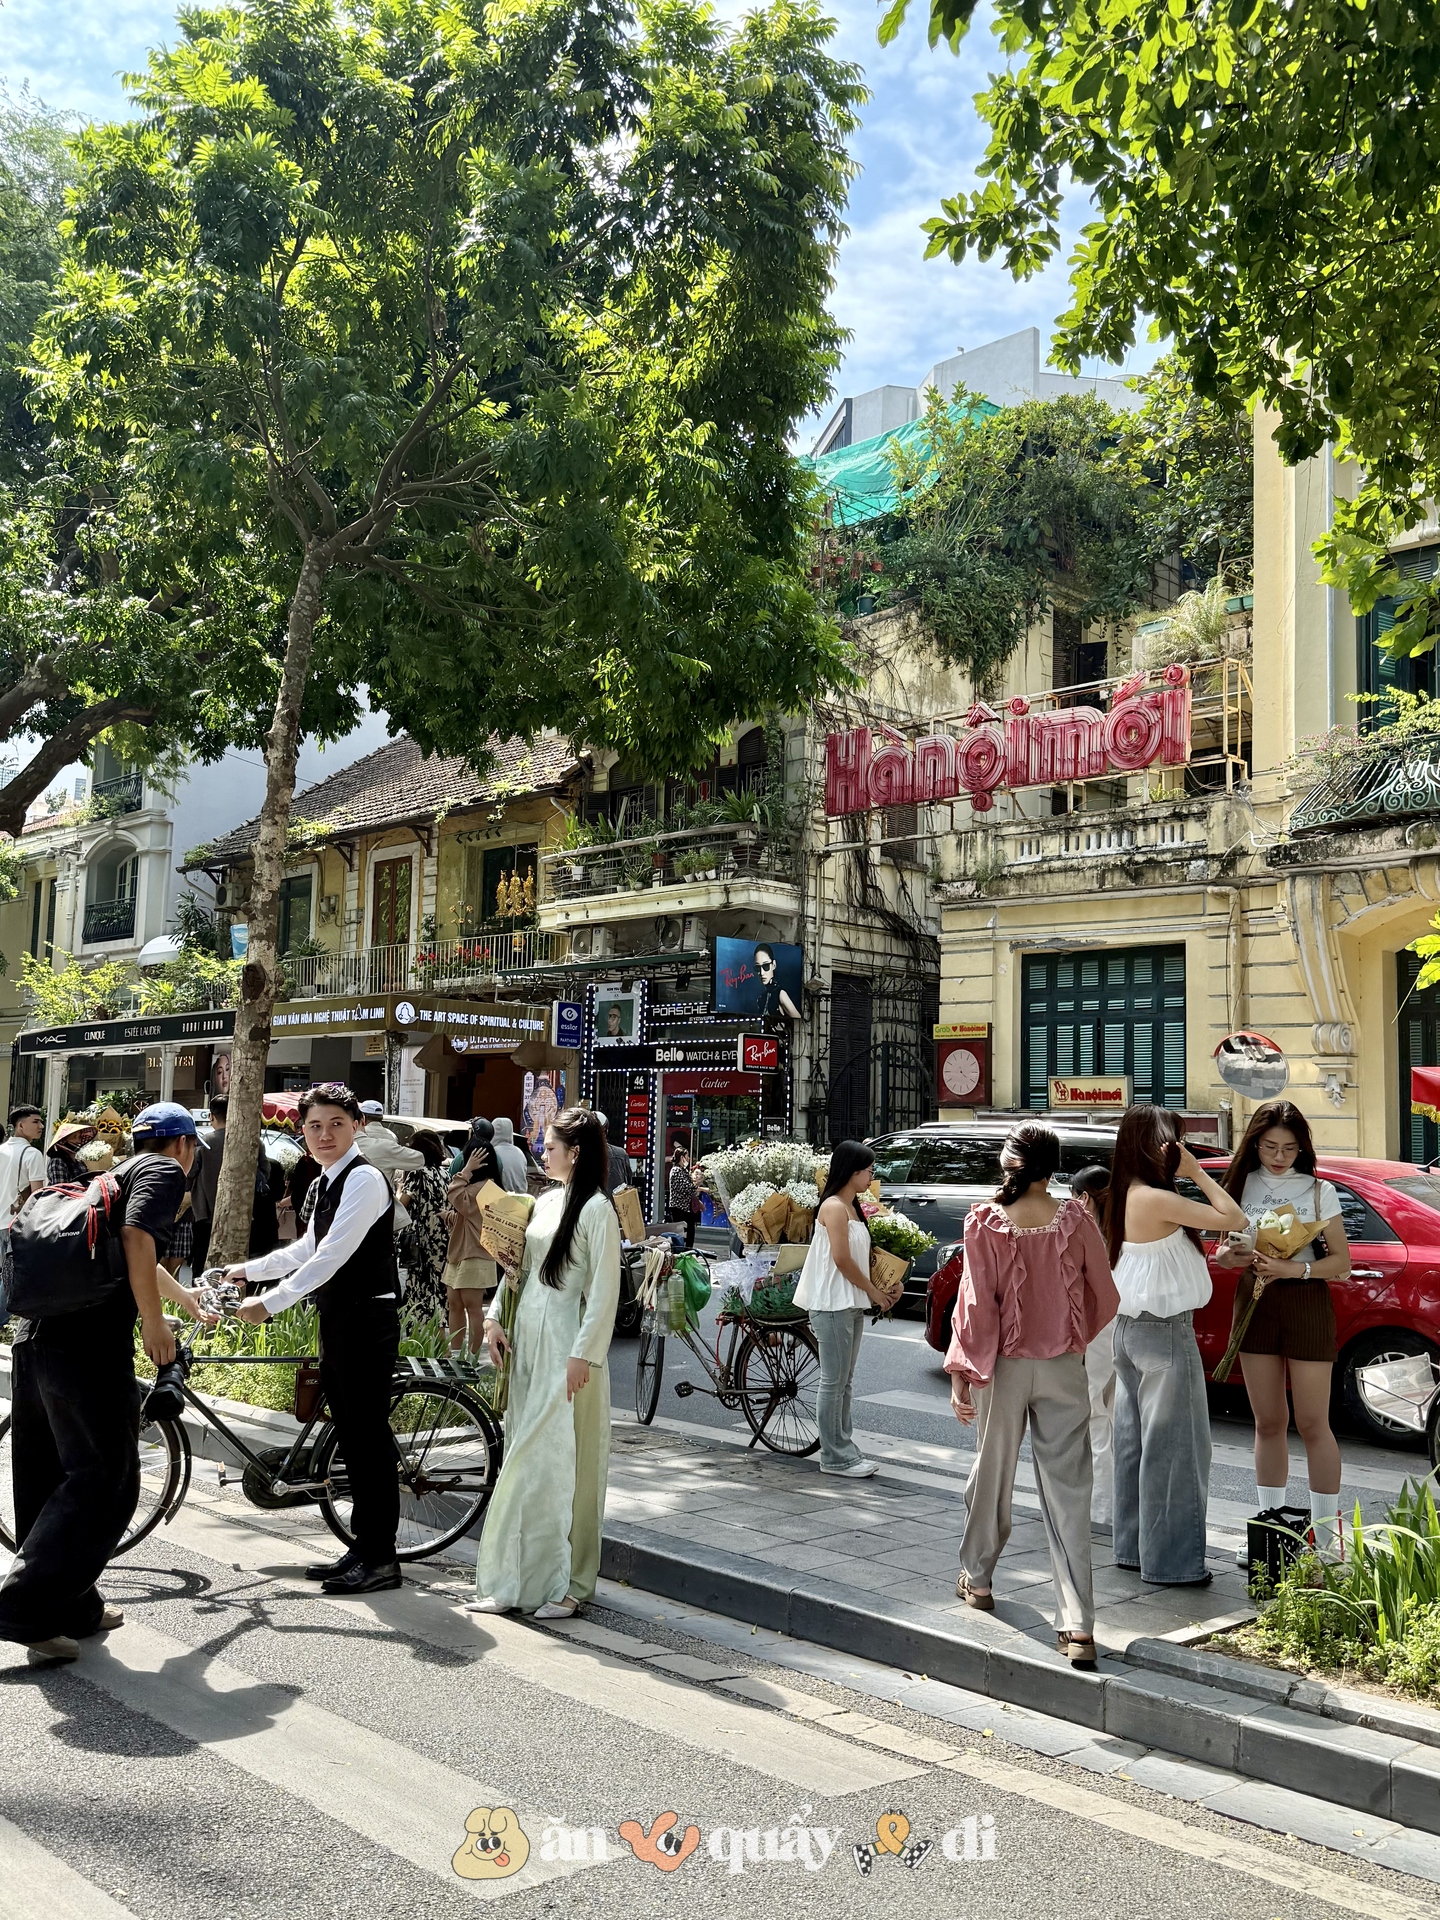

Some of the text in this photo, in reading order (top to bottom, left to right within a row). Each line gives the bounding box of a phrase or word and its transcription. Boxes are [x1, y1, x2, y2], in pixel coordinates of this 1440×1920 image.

[720, 965, 755, 989] Ray-Ban
[273, 1015, 287, 1026] GIAN
[288, 1012, 300, 1025] VĂN
[300, 1011, 312, 1023] HÓA
[313, 1009, 330, 1025] NGHỆ
[369, 1007, 385, 1019] LINH
[652, 1005, 708, 1016] PORSCHE
[203, 1019, 224, 1031] BROWN
[420, 1010, 545, 1031] THE ART SPACE OF SPIRITUAL & CULTURE
[139, 1025, 162, 1036] LAUDER
[560, 1023, 578, 1031] essilor
[84, 1030, 106, 1041] CLINIQUE
[655, 1047, 685, 1062] Bello
[686, 1052, 713, 1061] WATCH
[714, 1051, 721, 1060] &
[746, 1042, 776, 1062] Ray-Ban
[634, 1076, 645, 1086] 46
[700, 1077, 731, 1089] Cartier
